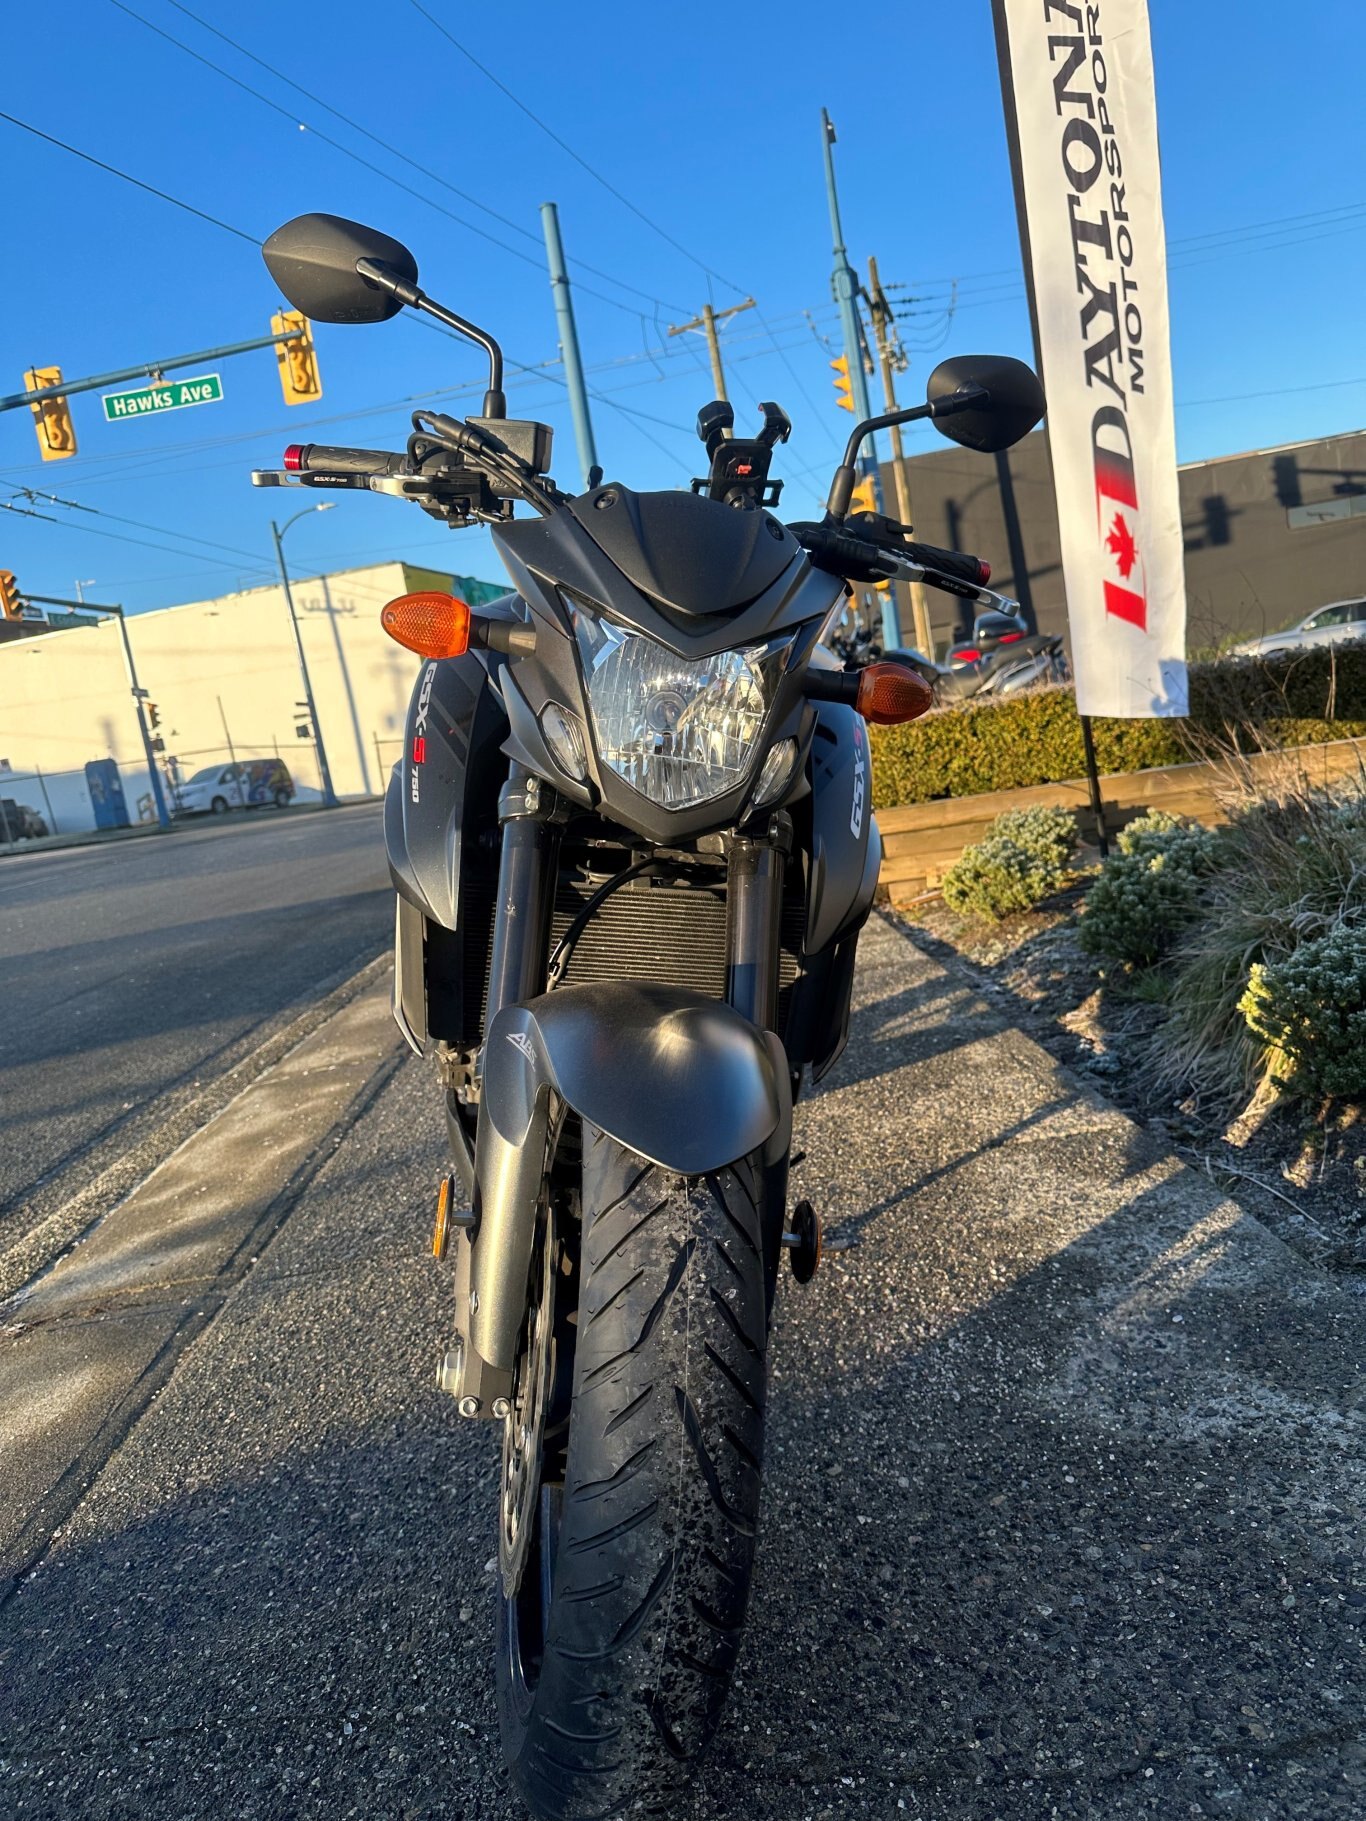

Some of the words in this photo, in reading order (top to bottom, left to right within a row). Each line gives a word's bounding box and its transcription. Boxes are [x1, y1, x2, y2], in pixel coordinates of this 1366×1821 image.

[1084, 0, 1145, 394] MOTORSPOR
[113, 391, 173, 416] Hawks
[180, 383, 213, 404] Ave
[411, 766, 420, 803] 750
[507, 1032, 537, 1065] ABS
